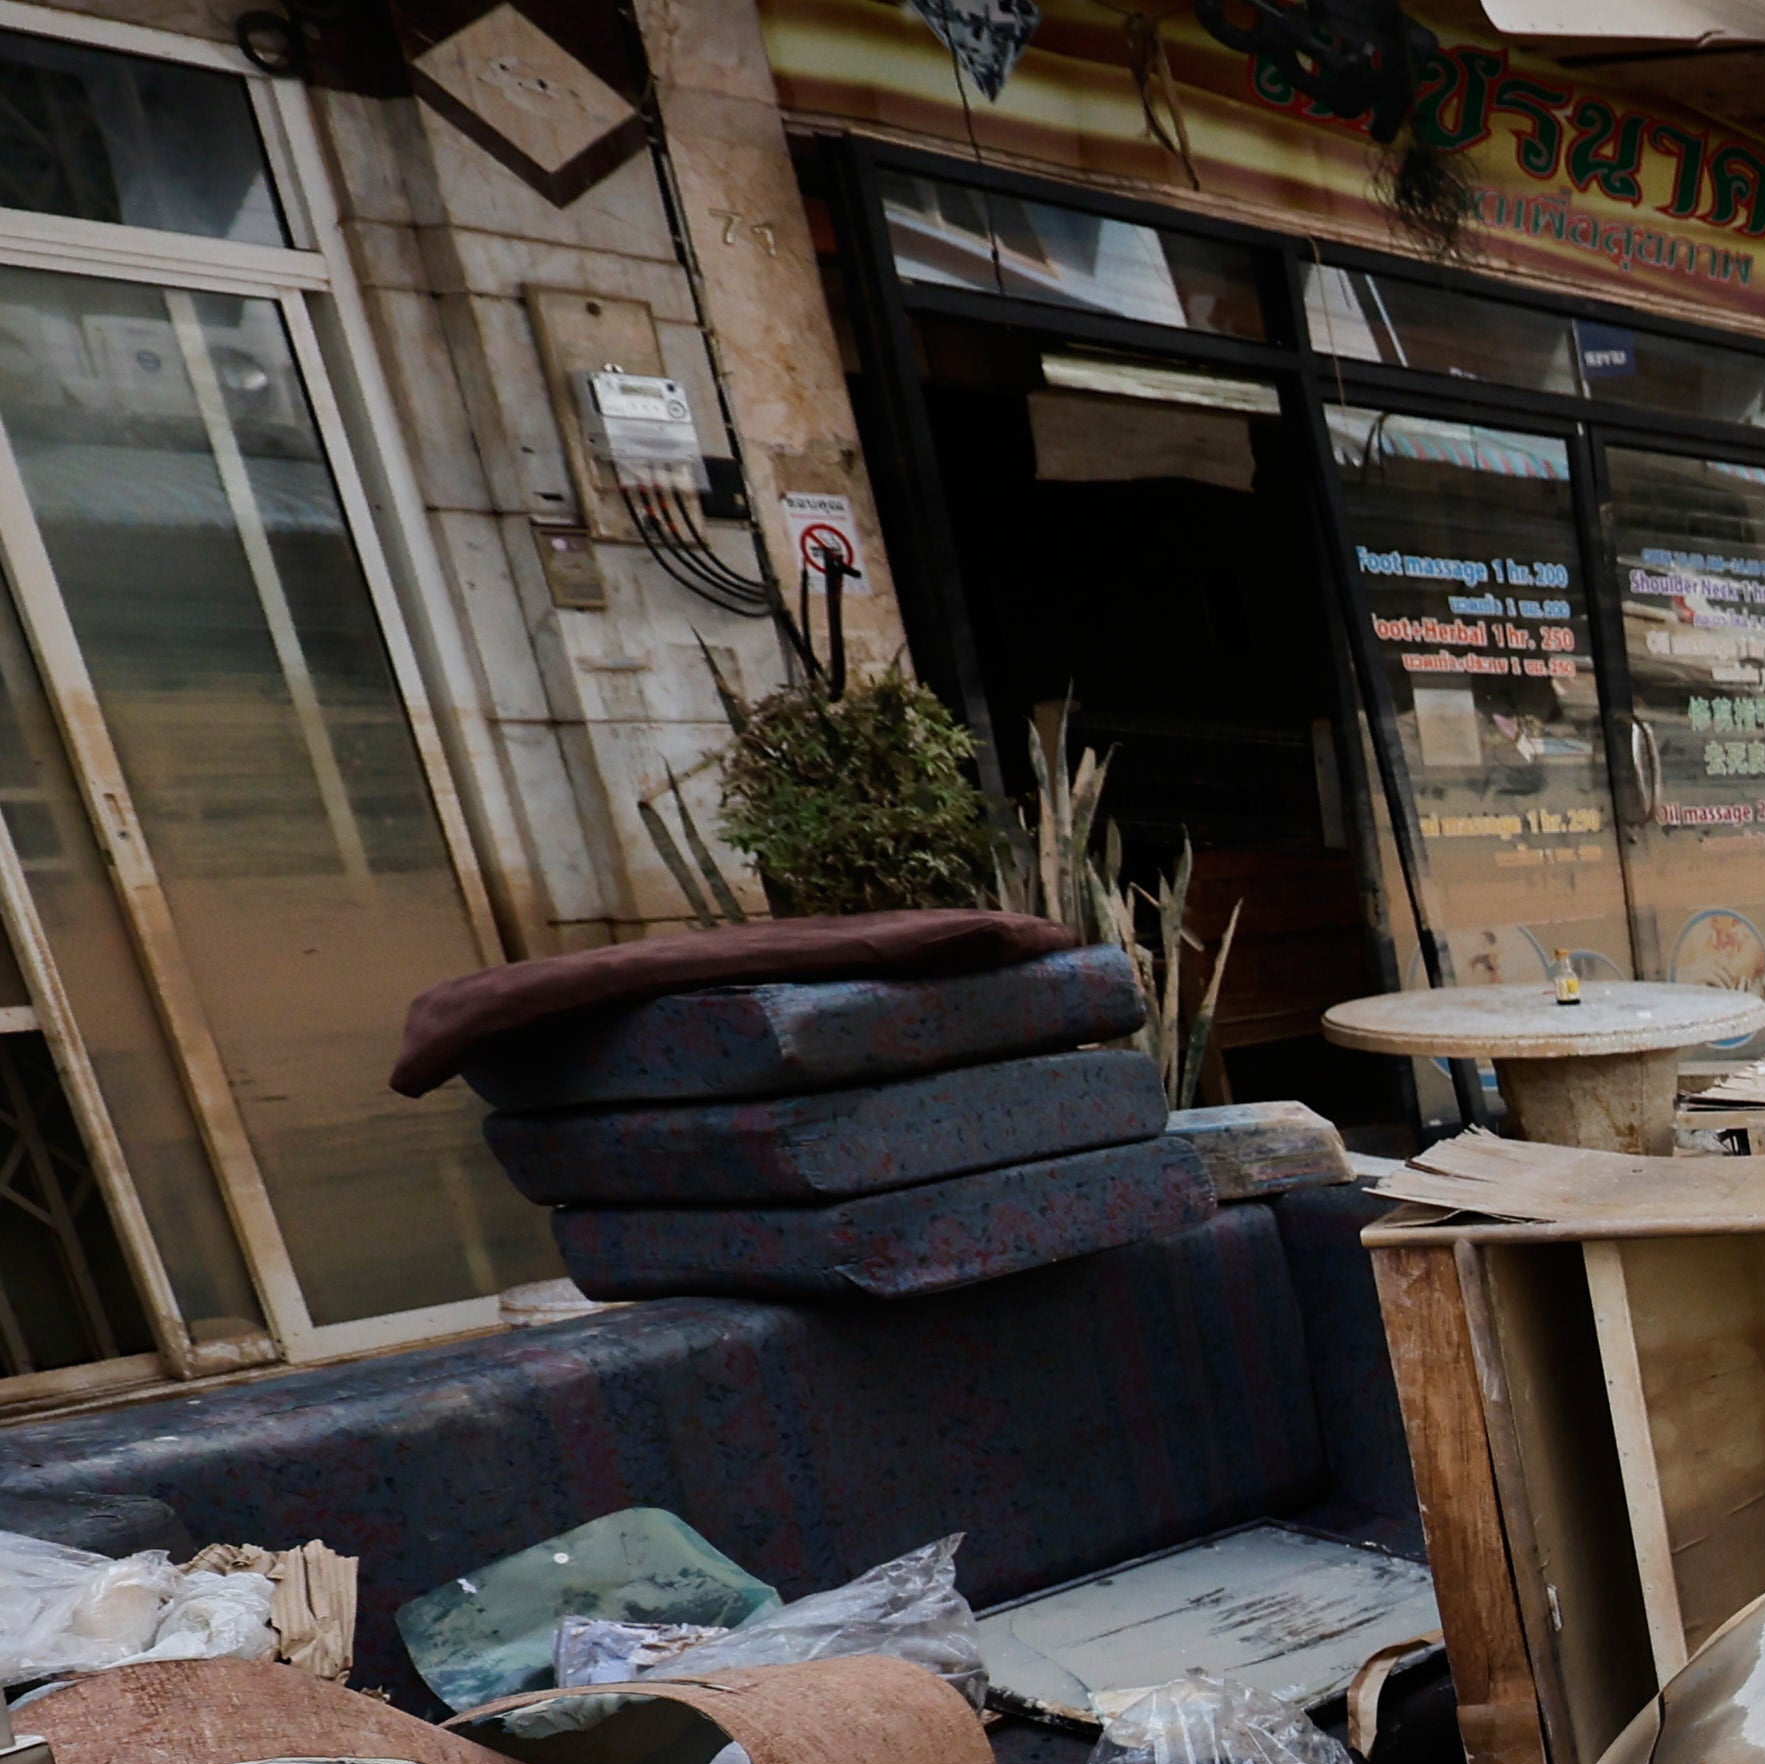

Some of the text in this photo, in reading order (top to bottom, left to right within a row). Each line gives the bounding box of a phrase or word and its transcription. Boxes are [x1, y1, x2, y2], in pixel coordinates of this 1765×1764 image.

[1403, 555, 1488, 588] massage
[1492, 557, 1505, 583] 1
[1372, 613, 1488, 647] oot+Herbal
[1492, 624, 1505, 648] 1
[1540, 627, 1575, 652] 250
[1682, 803, 1753, 828] massage
